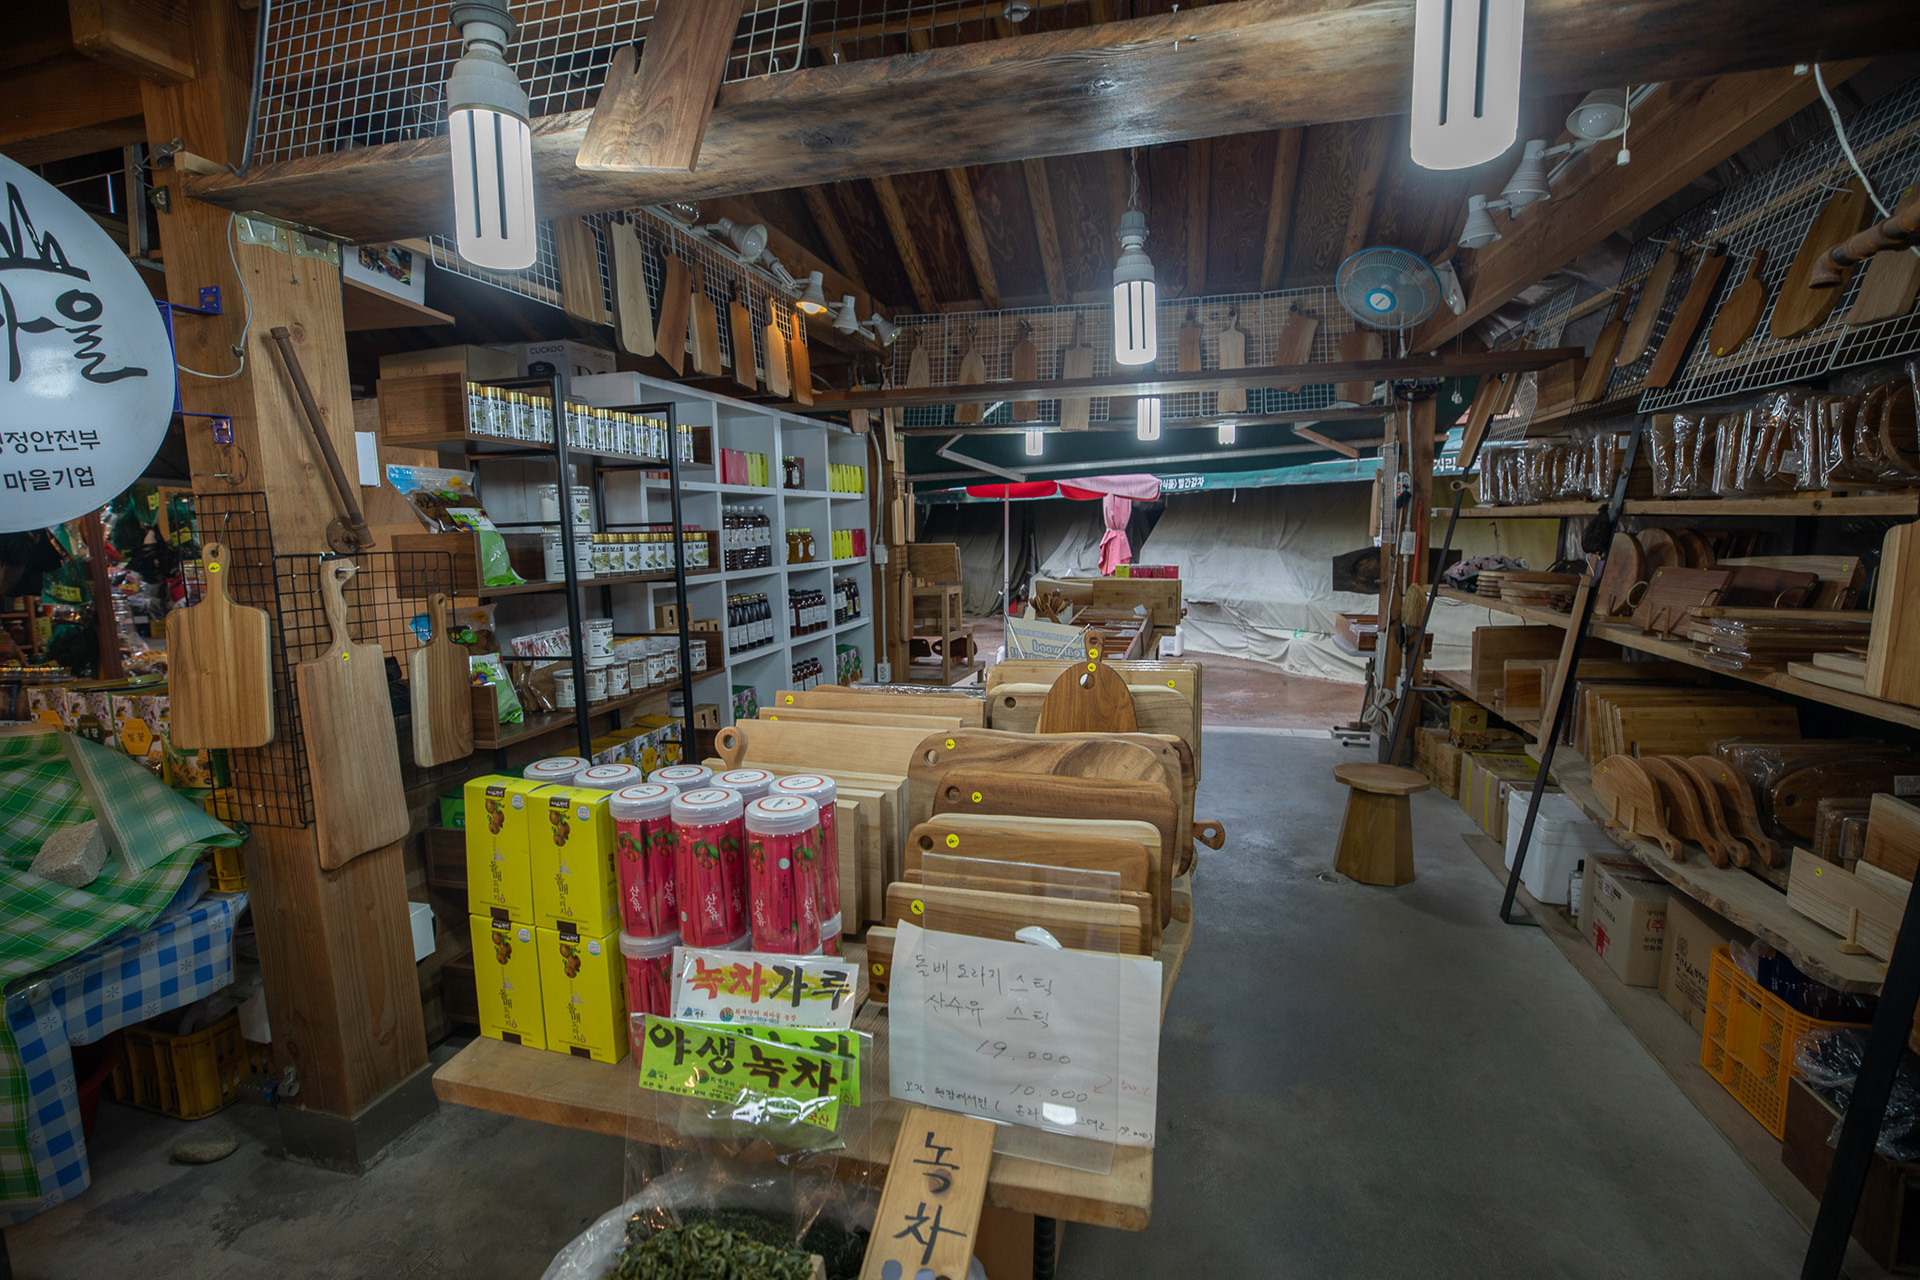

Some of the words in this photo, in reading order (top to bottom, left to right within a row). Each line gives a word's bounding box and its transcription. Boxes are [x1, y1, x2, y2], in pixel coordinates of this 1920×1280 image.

[529, 344, 565, 355] CUCKOO
[3, 466, 96, 493] 마을기업
[1178, 476, 1205, 489] 빨간감자
[127, 732, 145, 743] 벌꿀
[686, 956, 851, 1011] 녹차가루
[1009, 974, 1053, 997] 스틱
[924, 991, 985, 1029] 산수유
[1006, 1006, 1049, 1029] 스틱
[892, 1131, 968, 1266] 녹차
